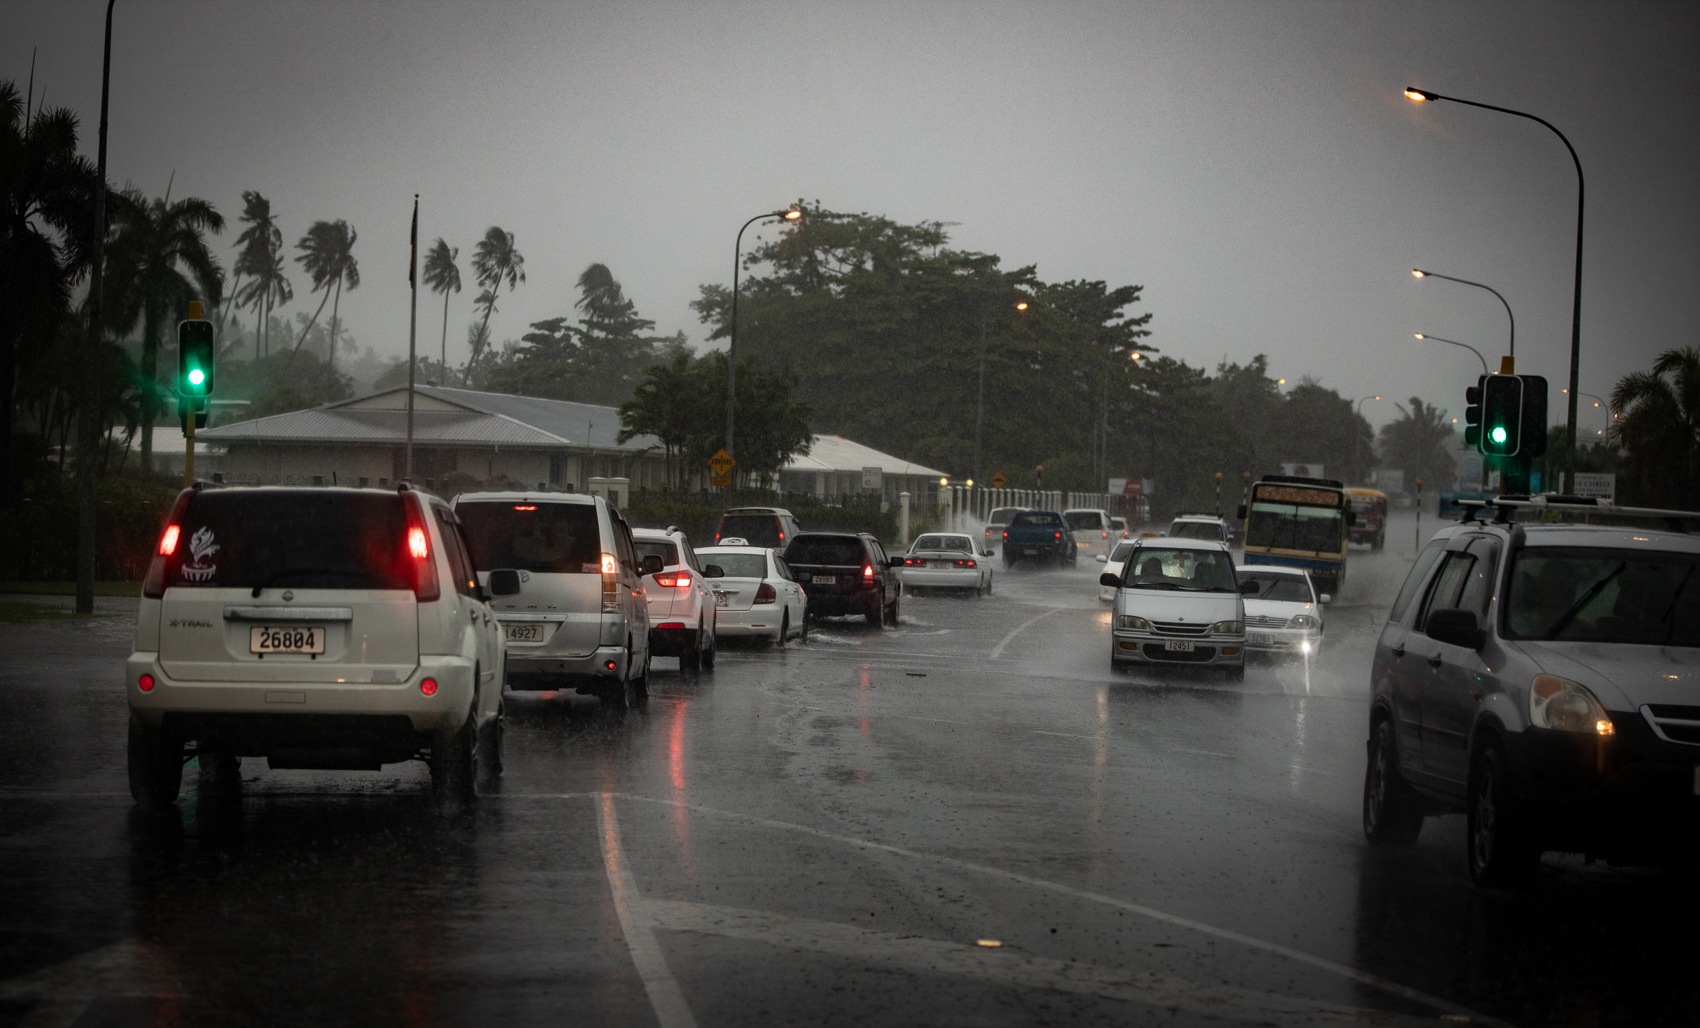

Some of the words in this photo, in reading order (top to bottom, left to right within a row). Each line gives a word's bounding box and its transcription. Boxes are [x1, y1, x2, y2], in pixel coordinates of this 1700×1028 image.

[169, 619, 213, 628] X-TRAIL
[505, 628, 537, 639] 14927
[260, 631, 315, 649] 26804
[1169, 642, 1190, 652] 12451
